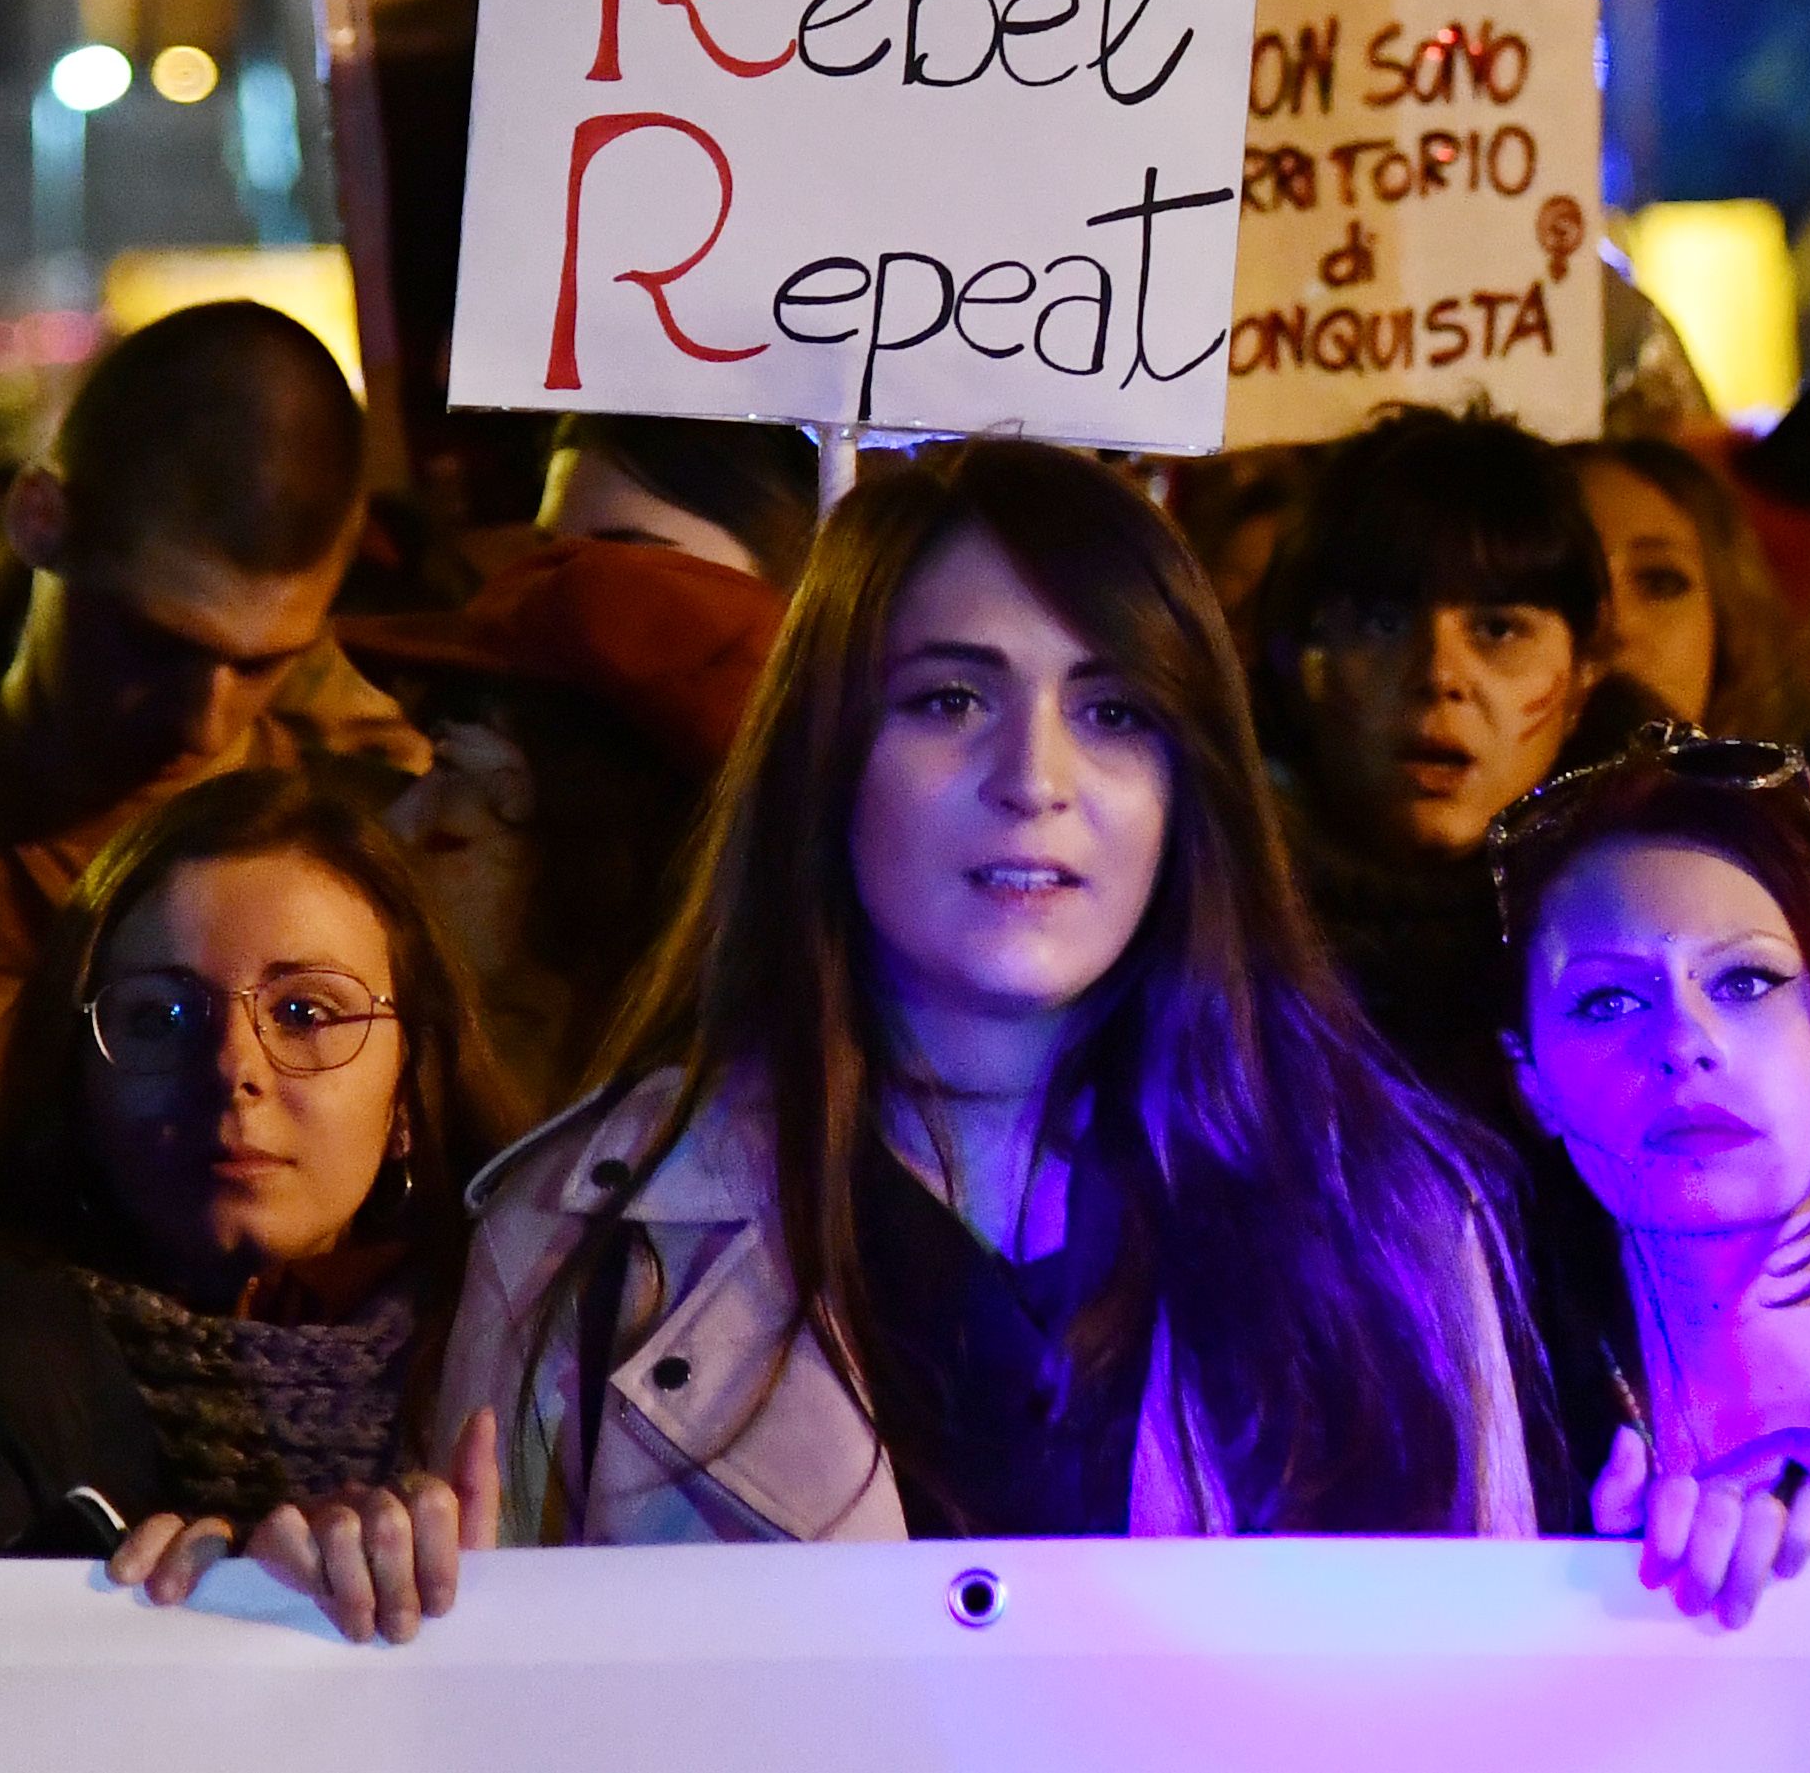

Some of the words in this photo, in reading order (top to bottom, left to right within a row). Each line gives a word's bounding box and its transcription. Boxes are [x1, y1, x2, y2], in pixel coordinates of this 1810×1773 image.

[1362, 20, 1531, 106] SONO
[544, 111, 1232, 420] Repeat
[1319, 219, 1377, 289] di
